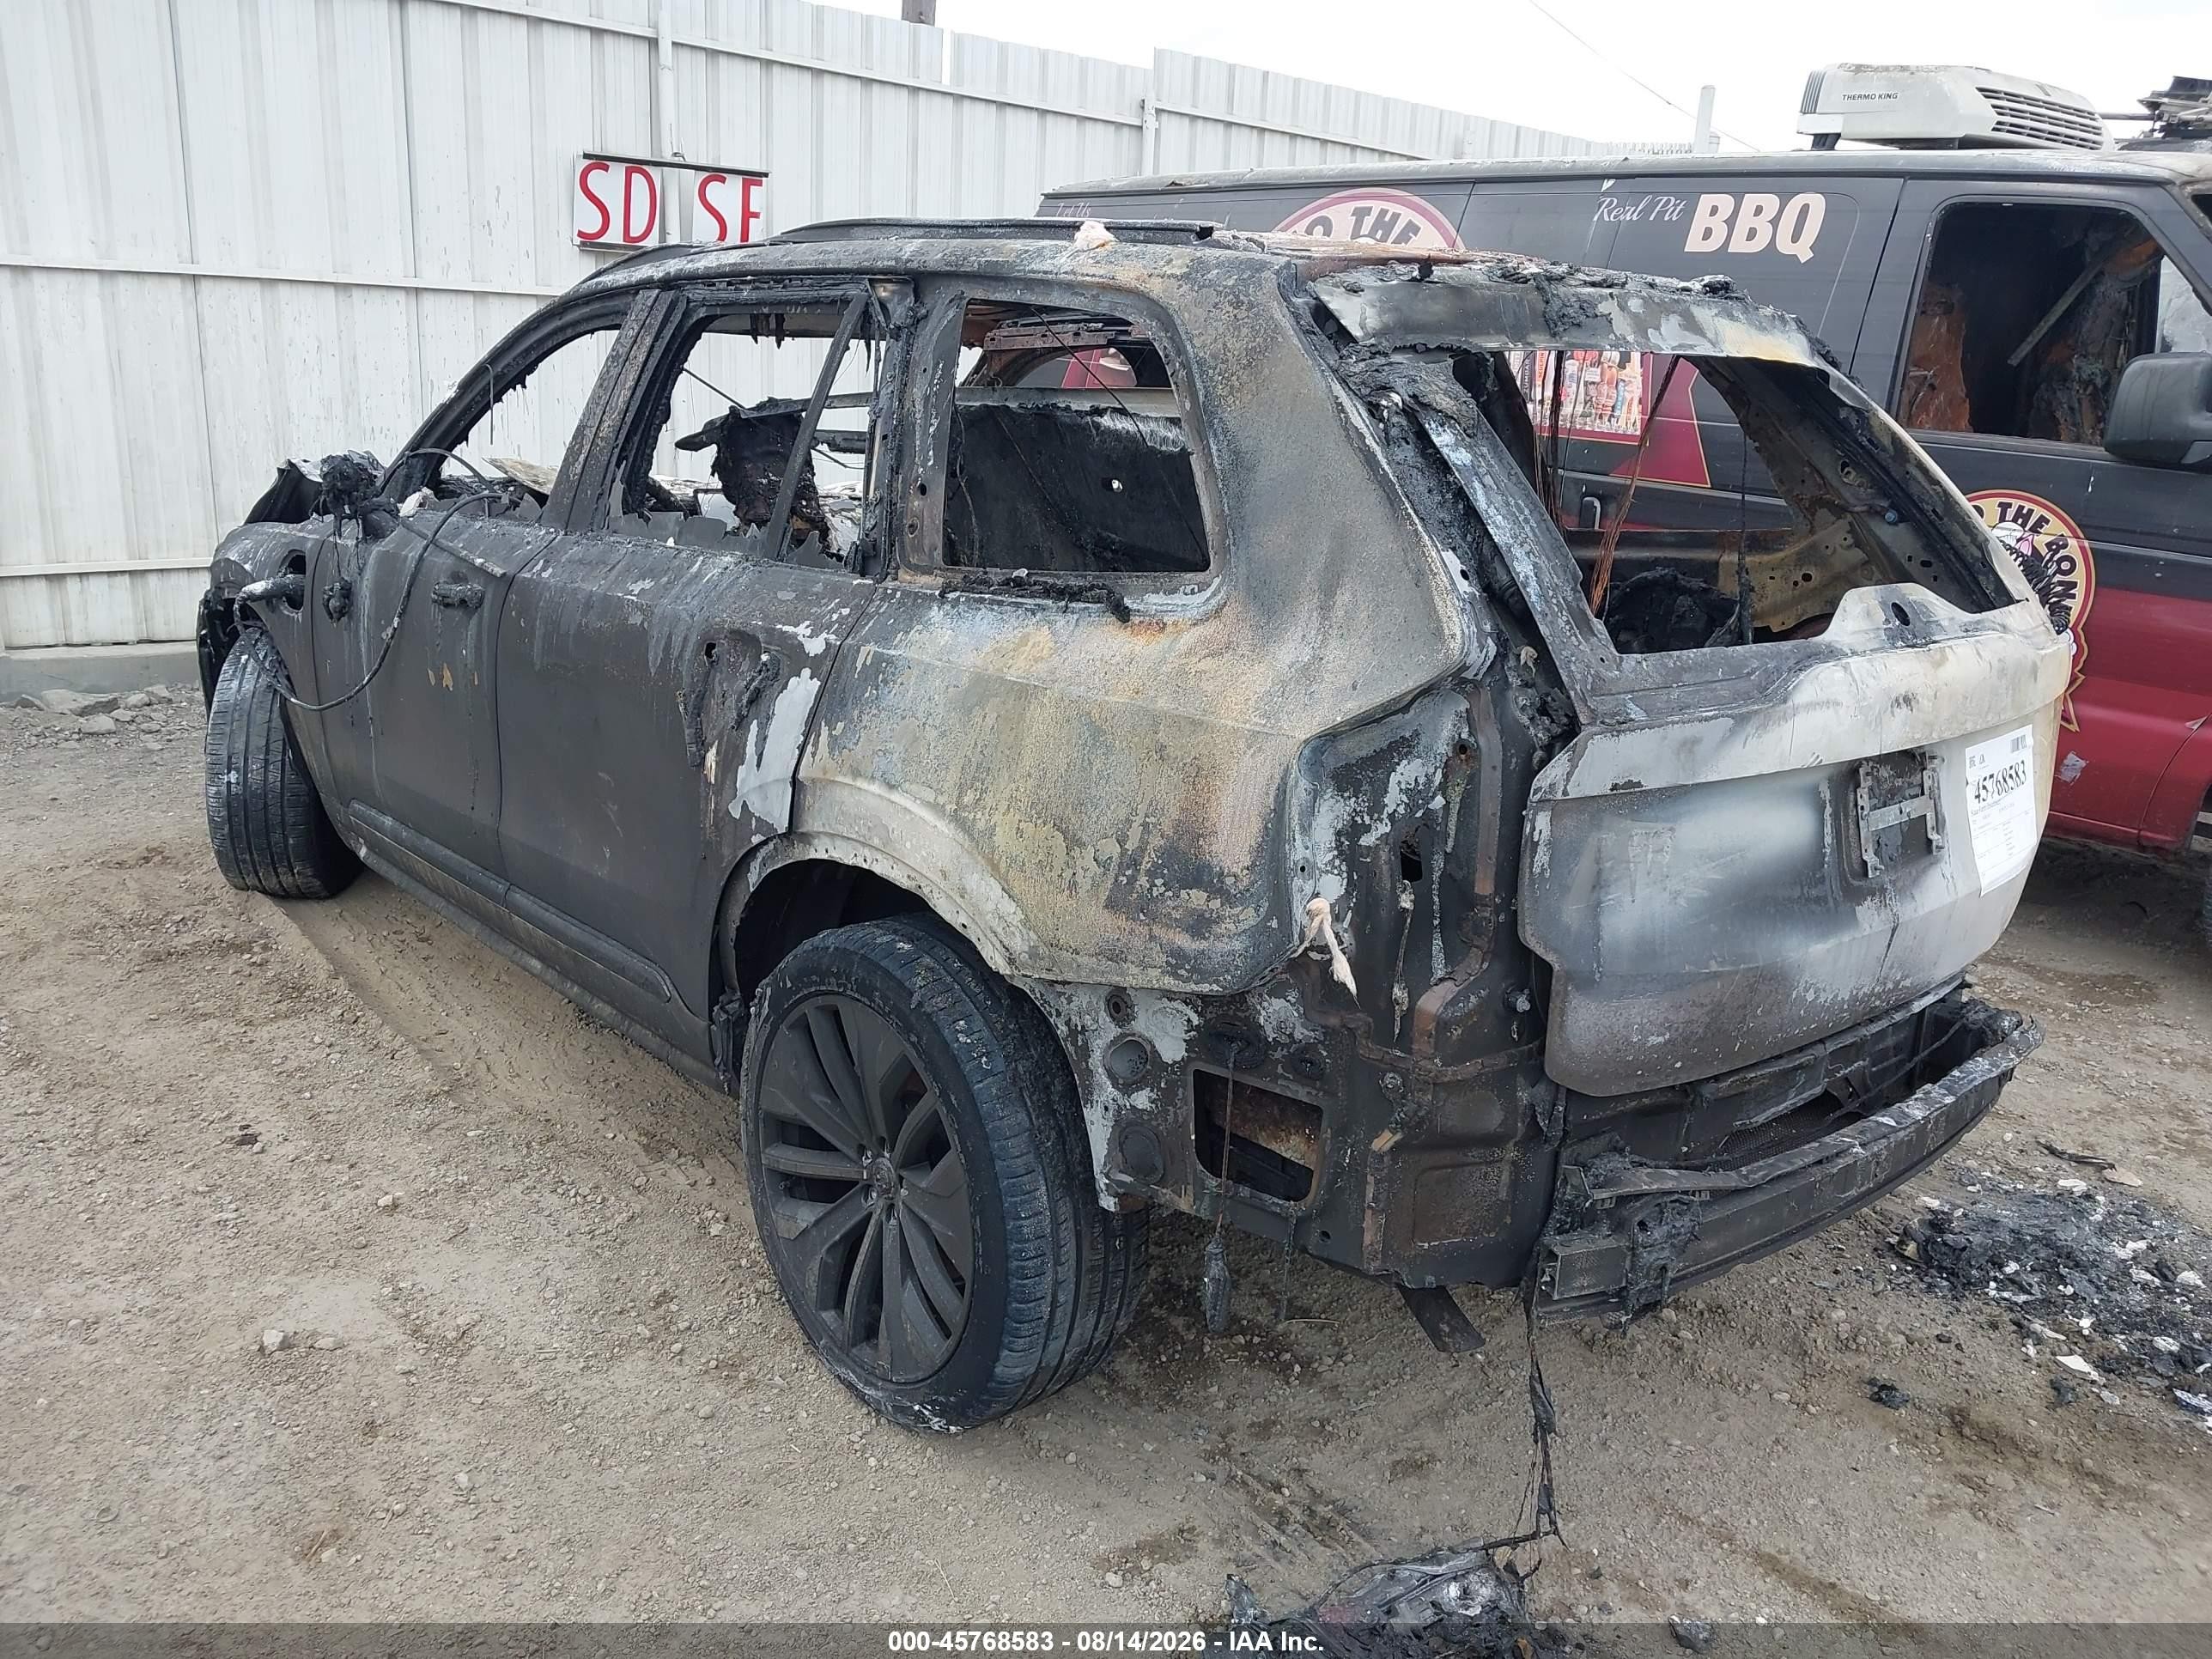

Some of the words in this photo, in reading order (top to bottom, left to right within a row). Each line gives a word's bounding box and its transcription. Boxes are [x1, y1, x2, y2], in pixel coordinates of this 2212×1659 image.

[1842, 93, 1876, 101] THERMO
[1878, 92, 1899, 100] KING
[576, 161, 658, 244] SD
[1592, 194, 1653, 222] Real
[1649, 195, 1689, 222] Pit
[1684, 191, 1826, 264] BBQ
[1537, 350, 1546, 379] SCULPIN
[1996, 501, 2052, 534] THE
[1974, 759, 2027, 804] 45768583
